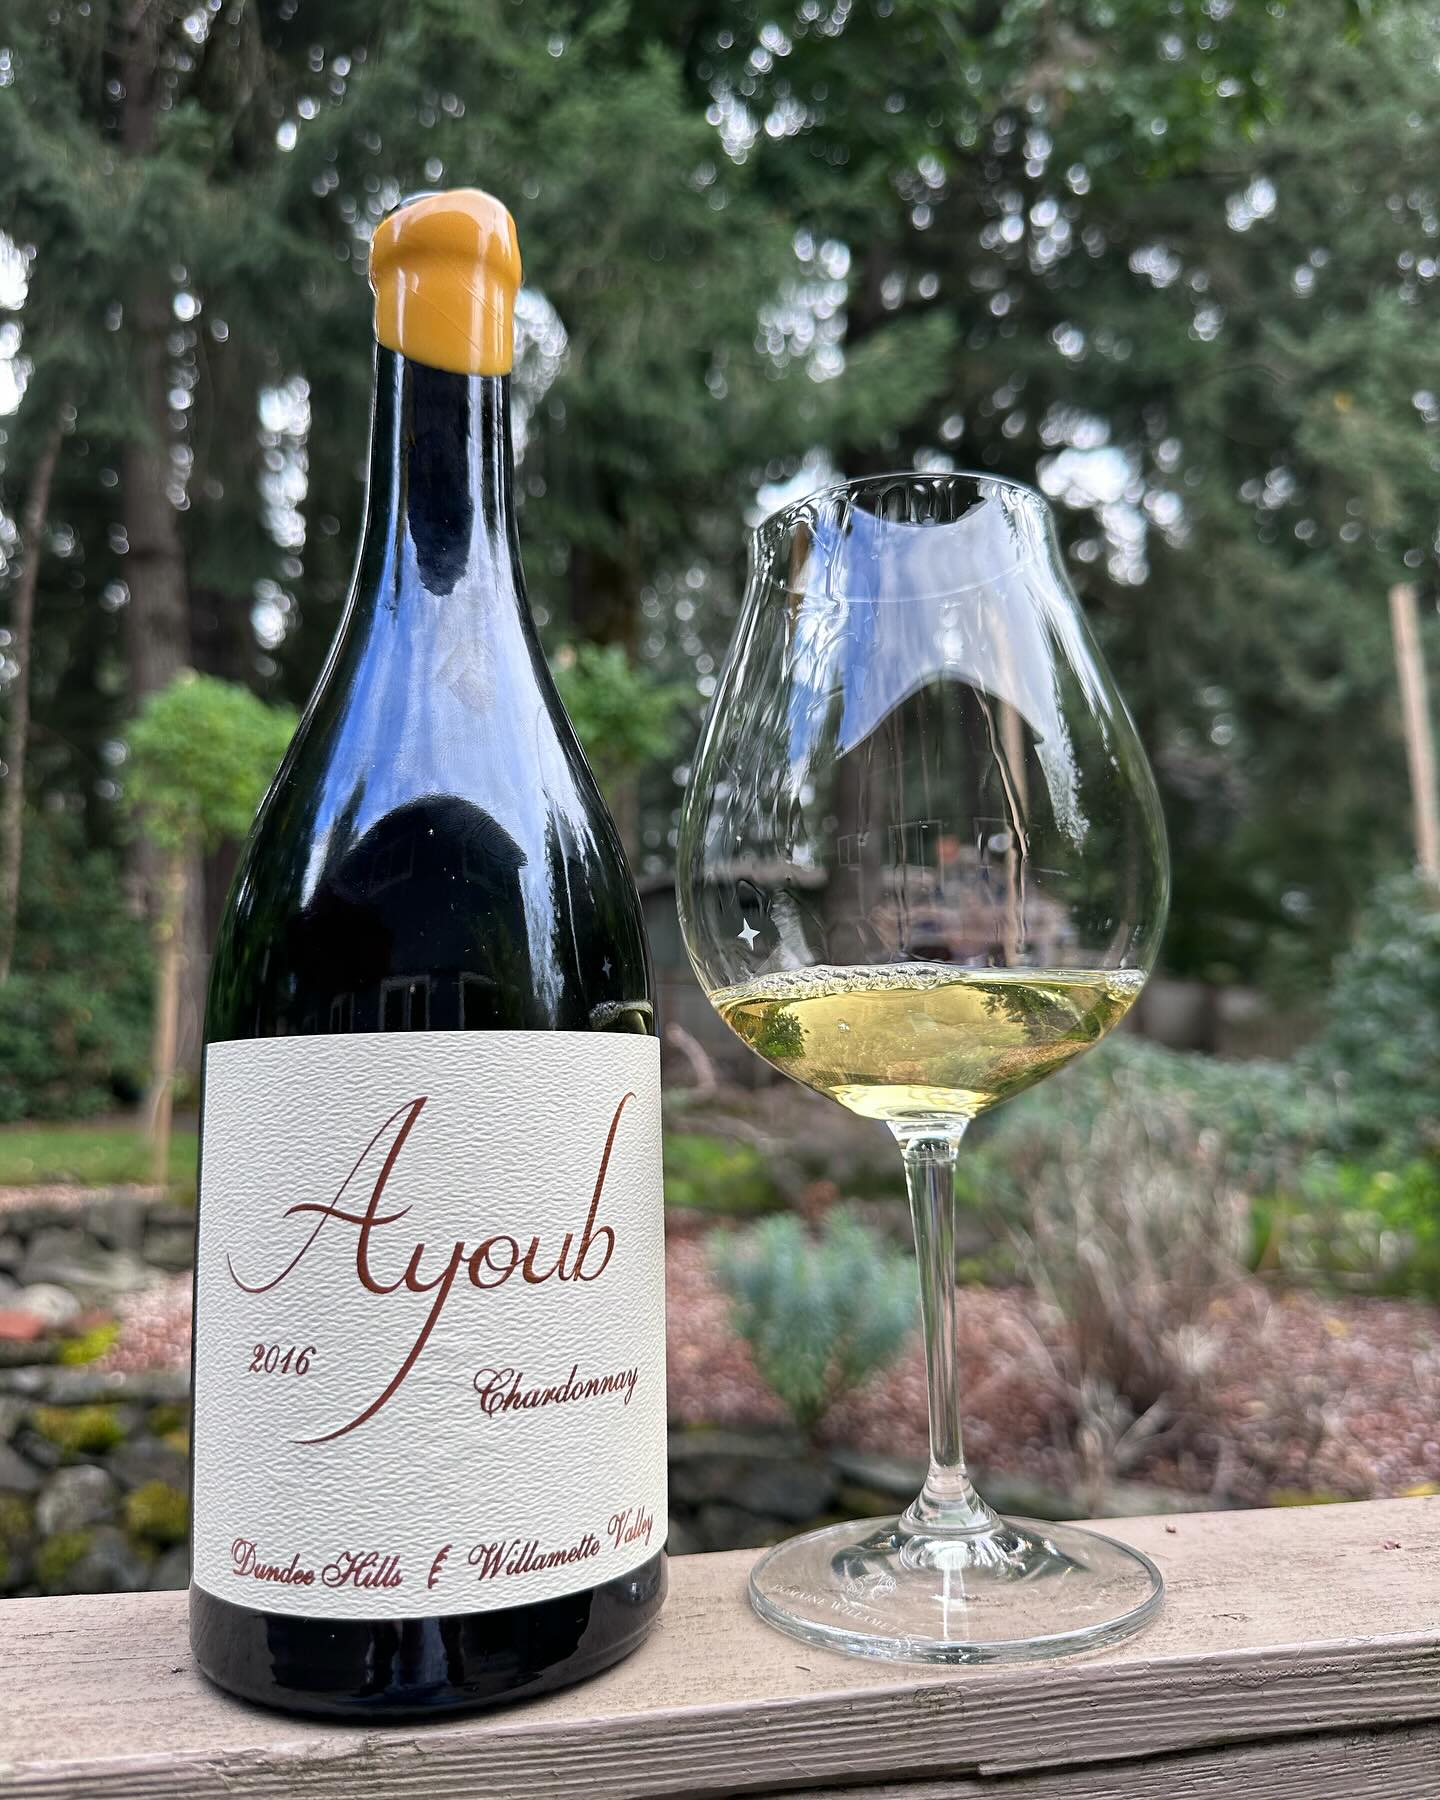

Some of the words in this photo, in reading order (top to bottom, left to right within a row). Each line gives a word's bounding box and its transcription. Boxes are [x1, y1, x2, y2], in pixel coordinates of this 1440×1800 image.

[227, 1091, 637, 1446] Ayoub
[248, 1343, 316, 1376] 2016
[473, 1364, 638, 1418] Chardonnay
[231, 1538, 316, 1586] Dundee
[321, 1551, 403, 1588] Hills
[467, 1532, 601, 1581] Willamette
[607, 1505, 654, 1550] Valley
